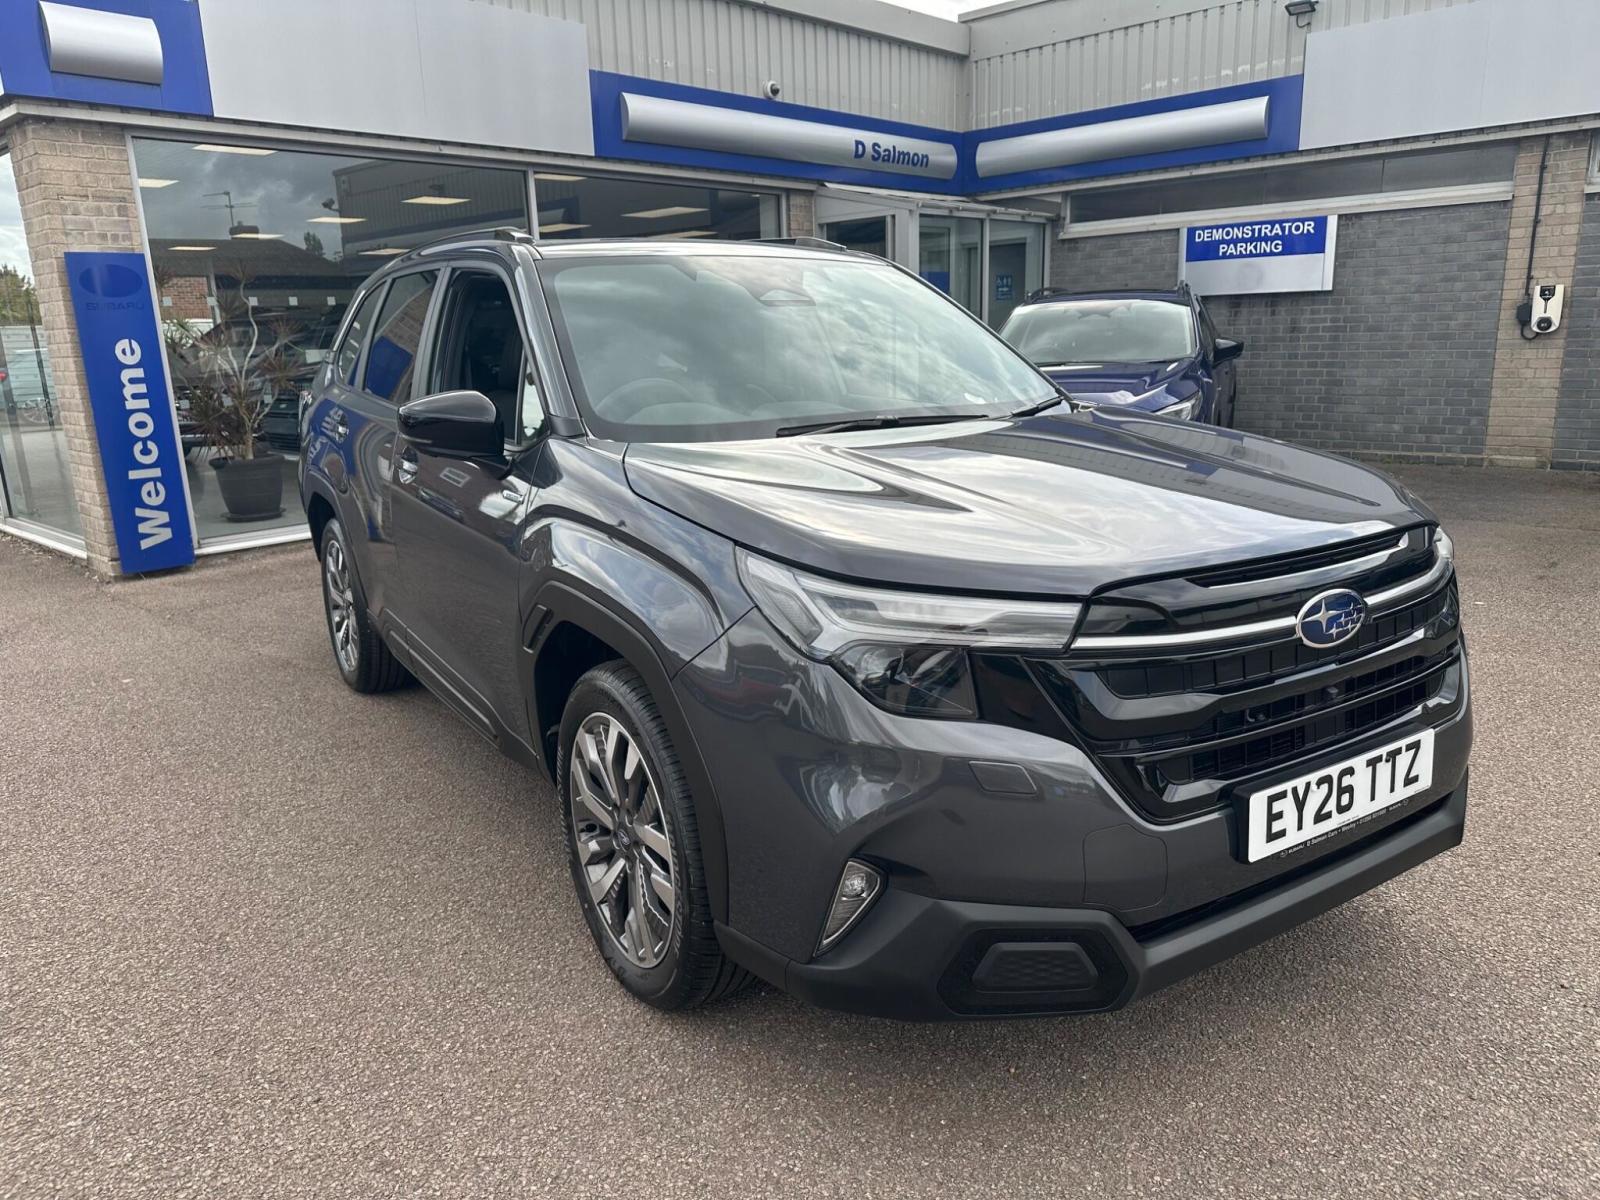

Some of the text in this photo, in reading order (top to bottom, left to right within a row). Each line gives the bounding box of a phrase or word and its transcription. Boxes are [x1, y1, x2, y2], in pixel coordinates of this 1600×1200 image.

[854, 139, 929, 168] D Salmon
[1195, 221, 1315, 242] DEMONSTRATOR
[1219, 240, 1283, 256] PARKING
[115, 338, 173, 550] Welcome
[1266, 739, 1421, 844] EY26 TTZ
